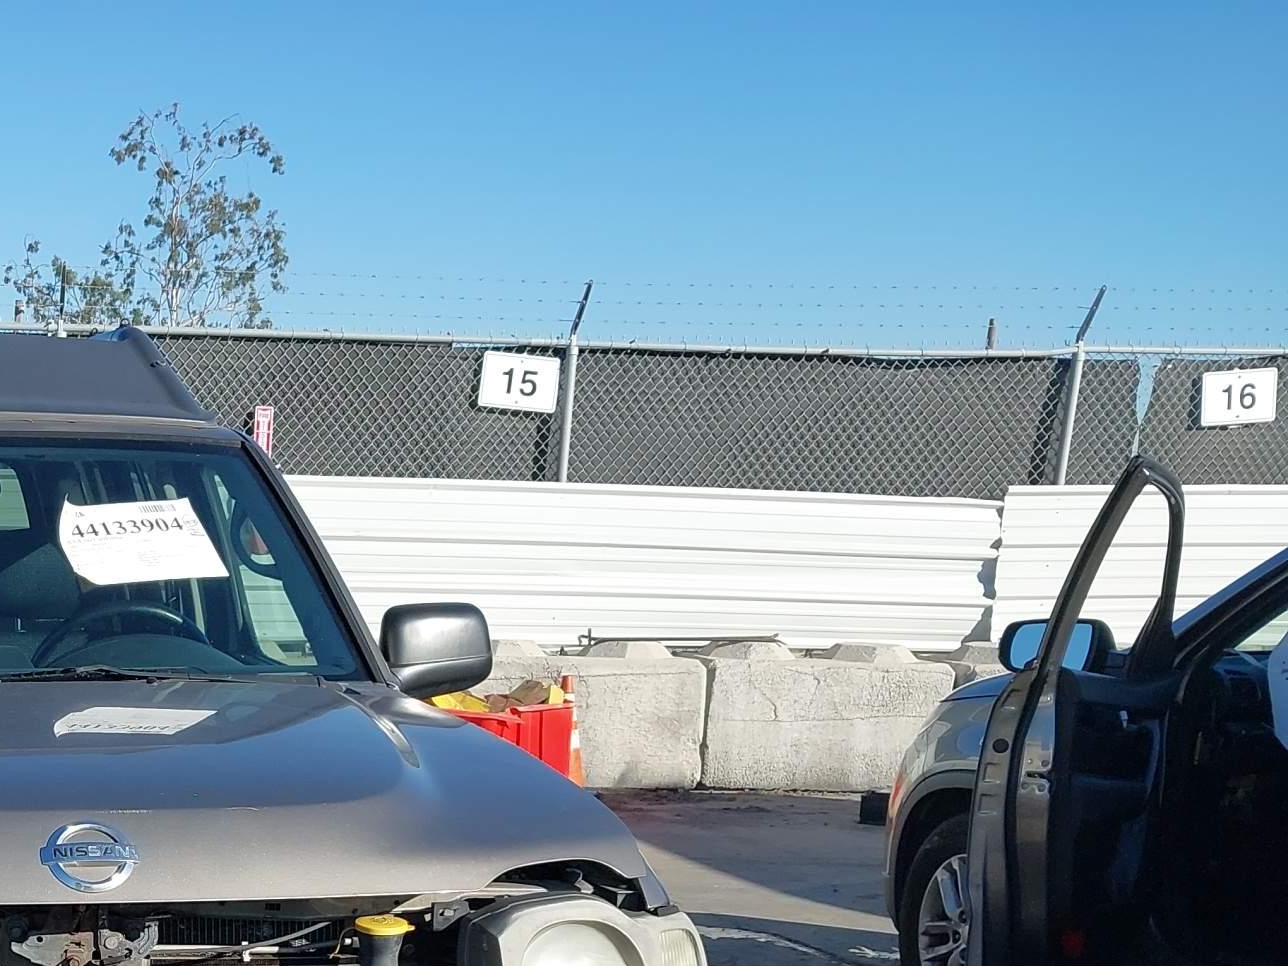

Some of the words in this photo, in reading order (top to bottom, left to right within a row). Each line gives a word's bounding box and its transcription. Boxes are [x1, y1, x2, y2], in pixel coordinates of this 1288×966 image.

[502, 367, 539, 397] 15
[1222, 382, 1257, 410] 16
[71, 517, 184, 538] 44133904
[53, 845, 130, 858] NISSAN
